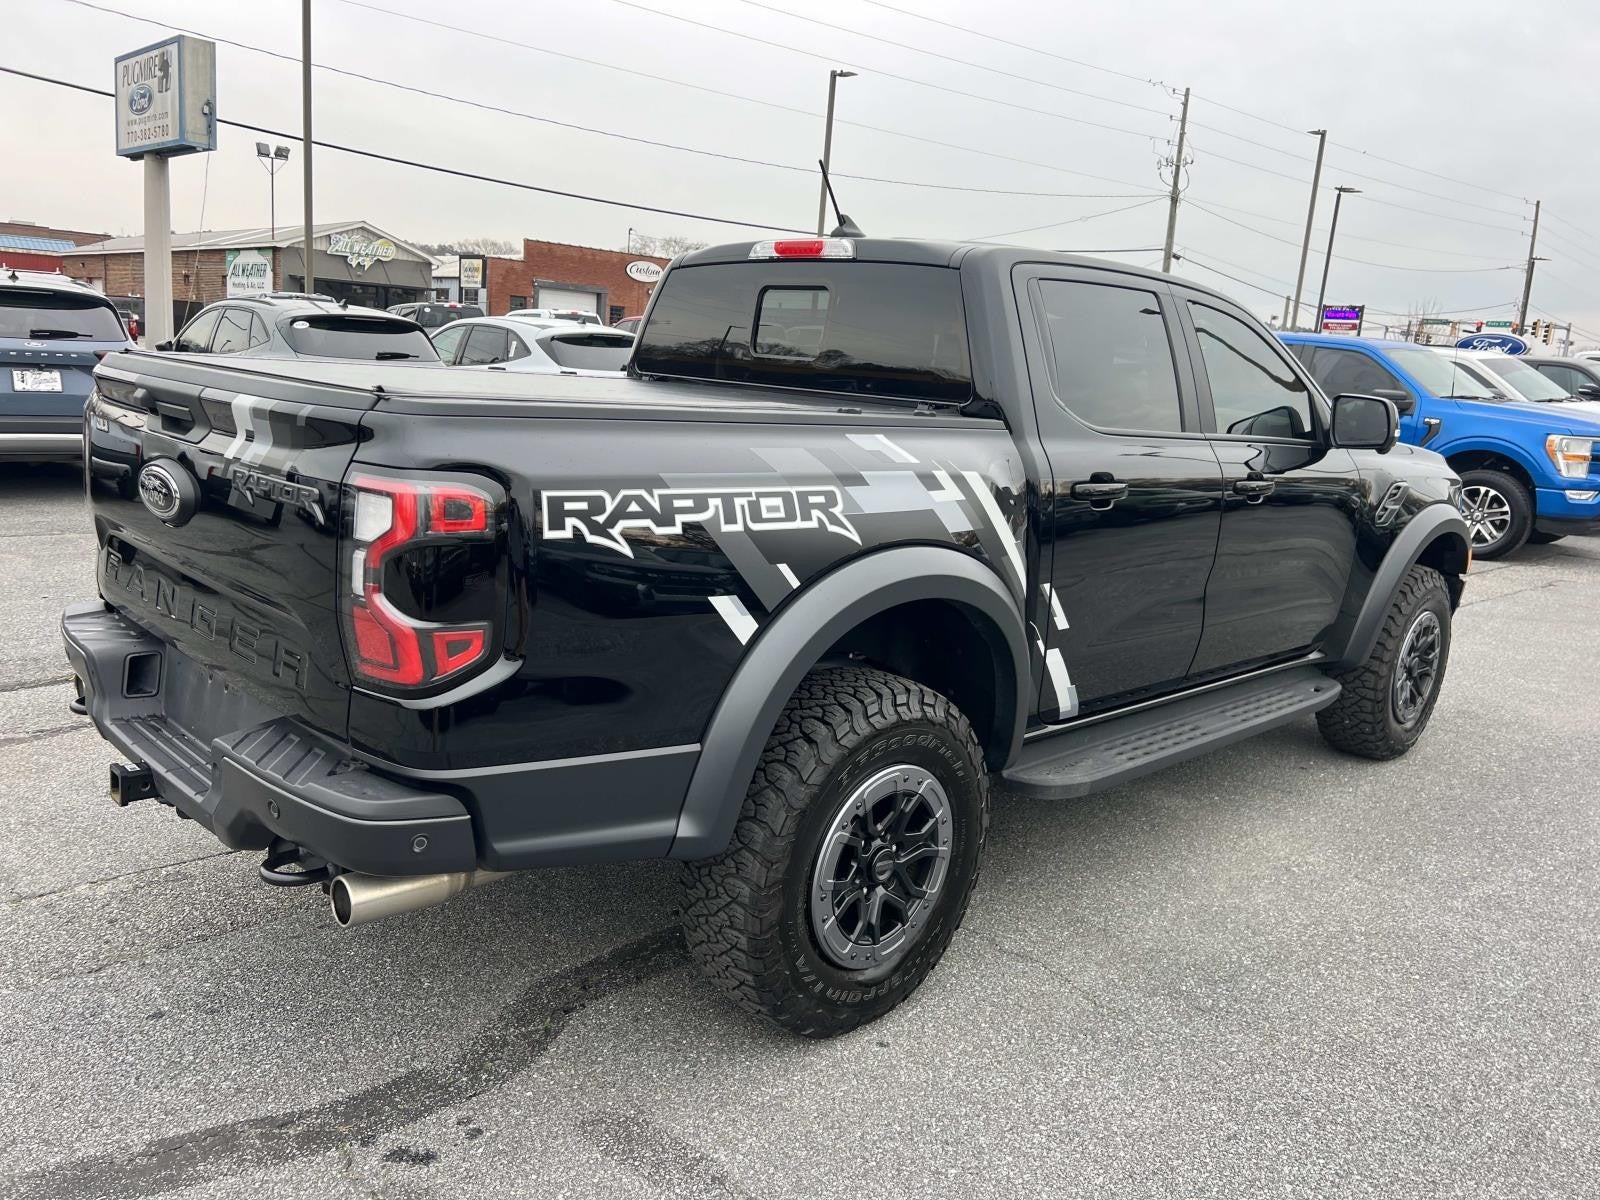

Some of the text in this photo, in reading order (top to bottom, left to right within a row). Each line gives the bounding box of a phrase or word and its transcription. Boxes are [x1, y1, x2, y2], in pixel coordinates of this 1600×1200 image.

[122, 54, 158, 88] PUGMIRE
[132, 88, 150, 111] Ford
[230, 263, 267, 279] ALL WEATHER
[1468, 338, 1511, 354] Ford
[231, 465, 325, 526] RAPTOR
[541, 485, 862, 559] RAPTOR
[105, 546, 310, 690] RANGER
